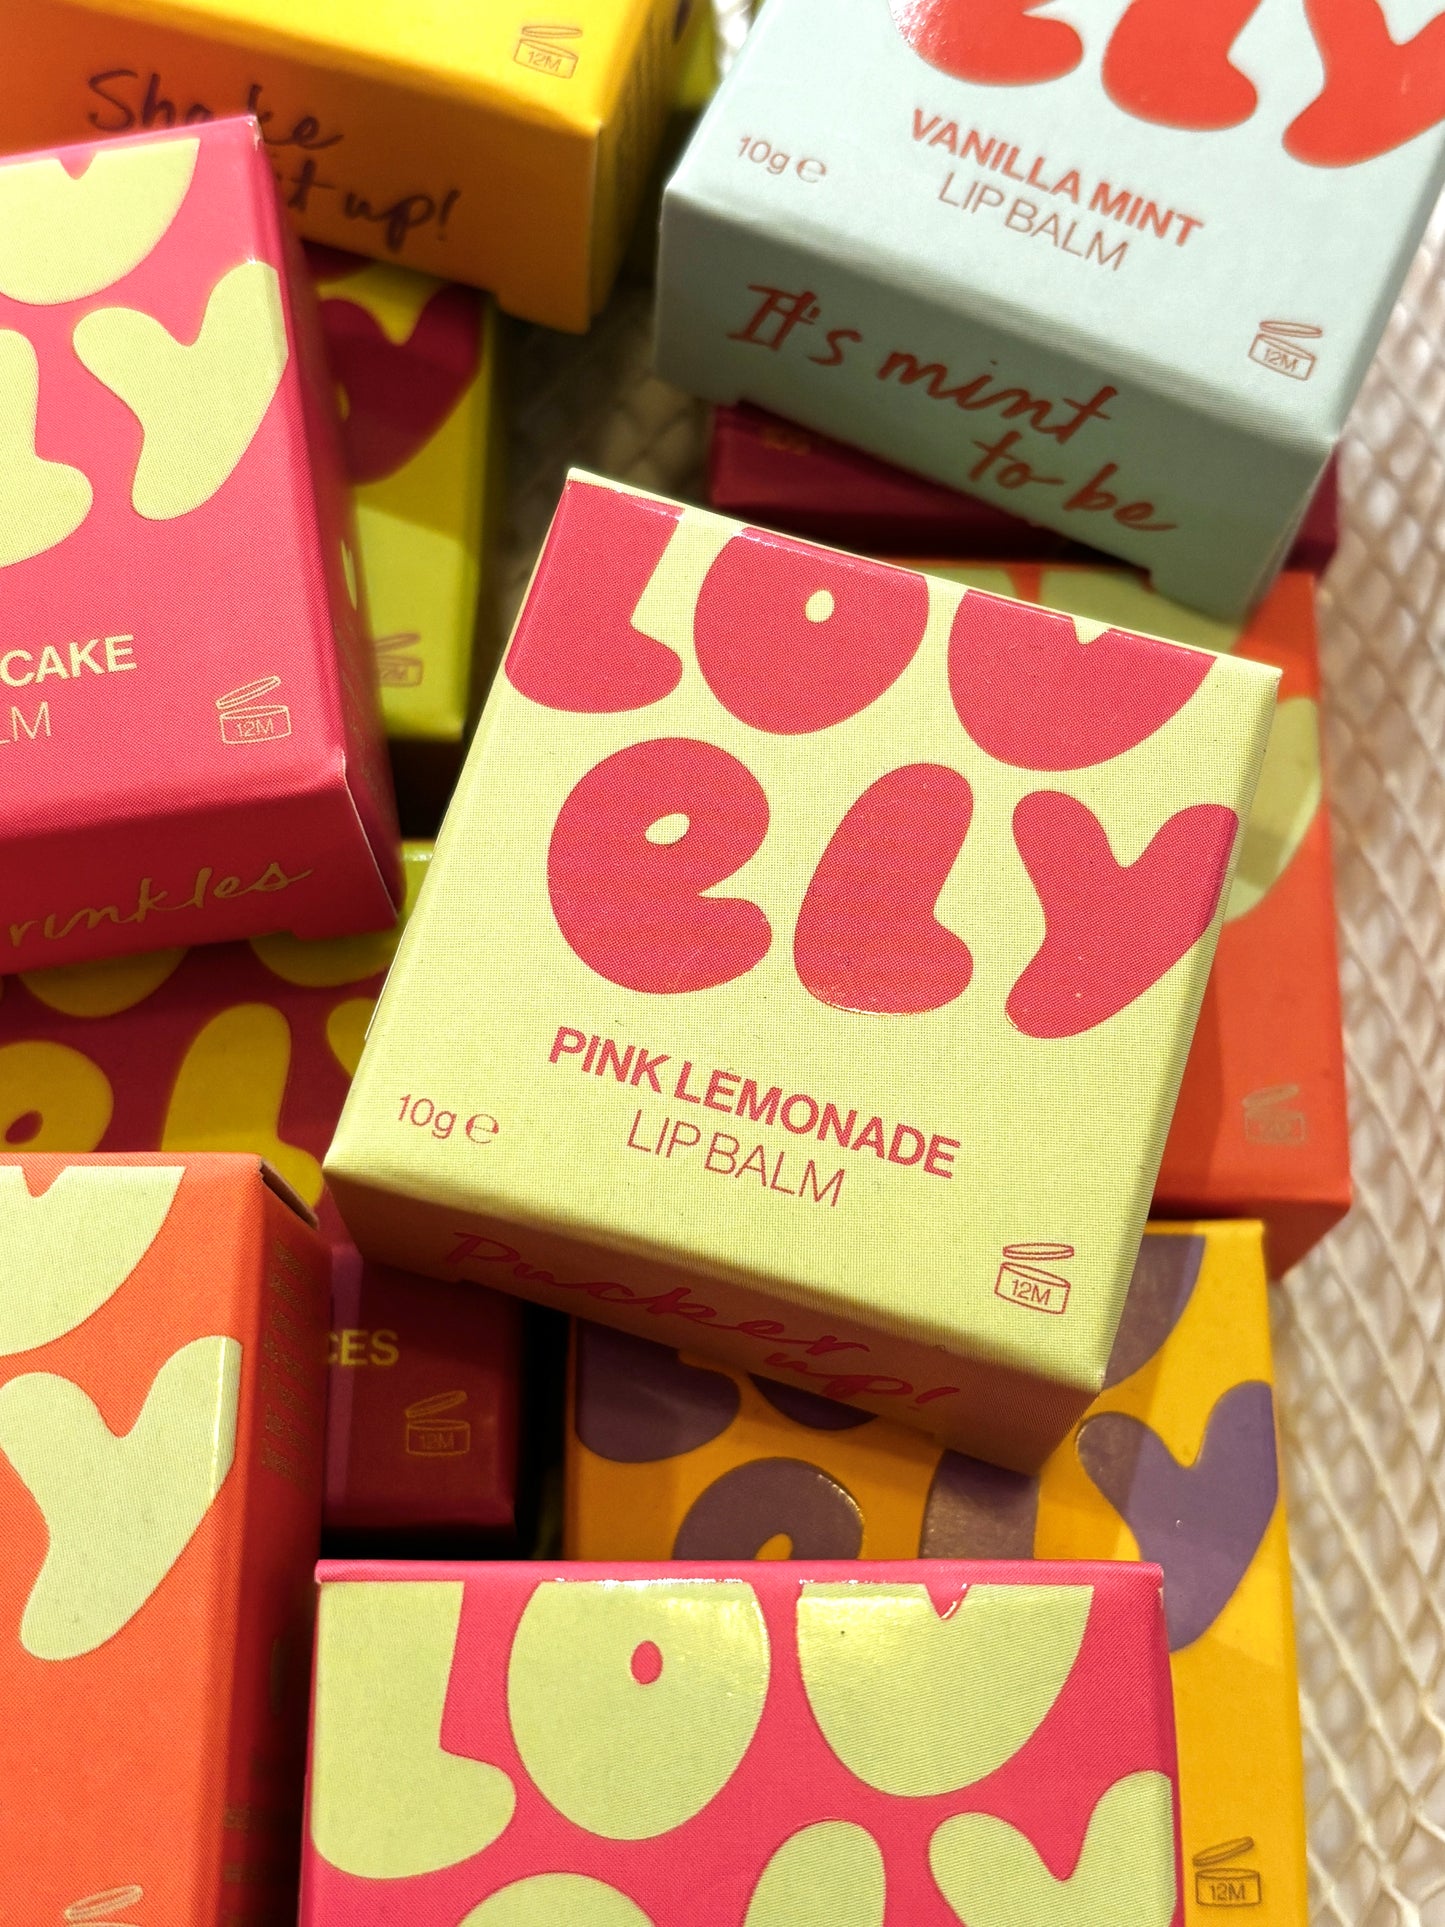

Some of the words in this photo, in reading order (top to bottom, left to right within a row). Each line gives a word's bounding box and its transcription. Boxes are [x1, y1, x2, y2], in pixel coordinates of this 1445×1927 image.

[528, 51, 562, 73] 12M
[737, 136, 790, 175] 10g
[911, 107, 1082, 203] VANILLA
[1088, 182, 1204, 249] MINT
[345, 188, 462, 253] up!
[937, 171, 1004, 214] LIP
[1004, 198, 1129, 272] BALM
[727, 283, 862, 366] It's
[877, 351, 1119, 445] mint
[1264, 348, 1298, 372] 12M
[970, 431, 1065, 490] to
[1062, 463, 1178, 532] be
[0, 634, 137, 688] CAKE
[234, 716, 275, 739] 12M
[397, 1093, 457, 1140] 10g
[549, 1026, 671, 1092] PINK
[674, 1061, 961, 1179] LEMONADE
[627, 1109, 701, 1160] LIP
[704, 1132, 846, 1207] BALM
[445, 1232, 870, 1356] Pucker
[1011, 1278, 1052, 1306] 12M
[1209, 1882, 1246, 1902] 12M
